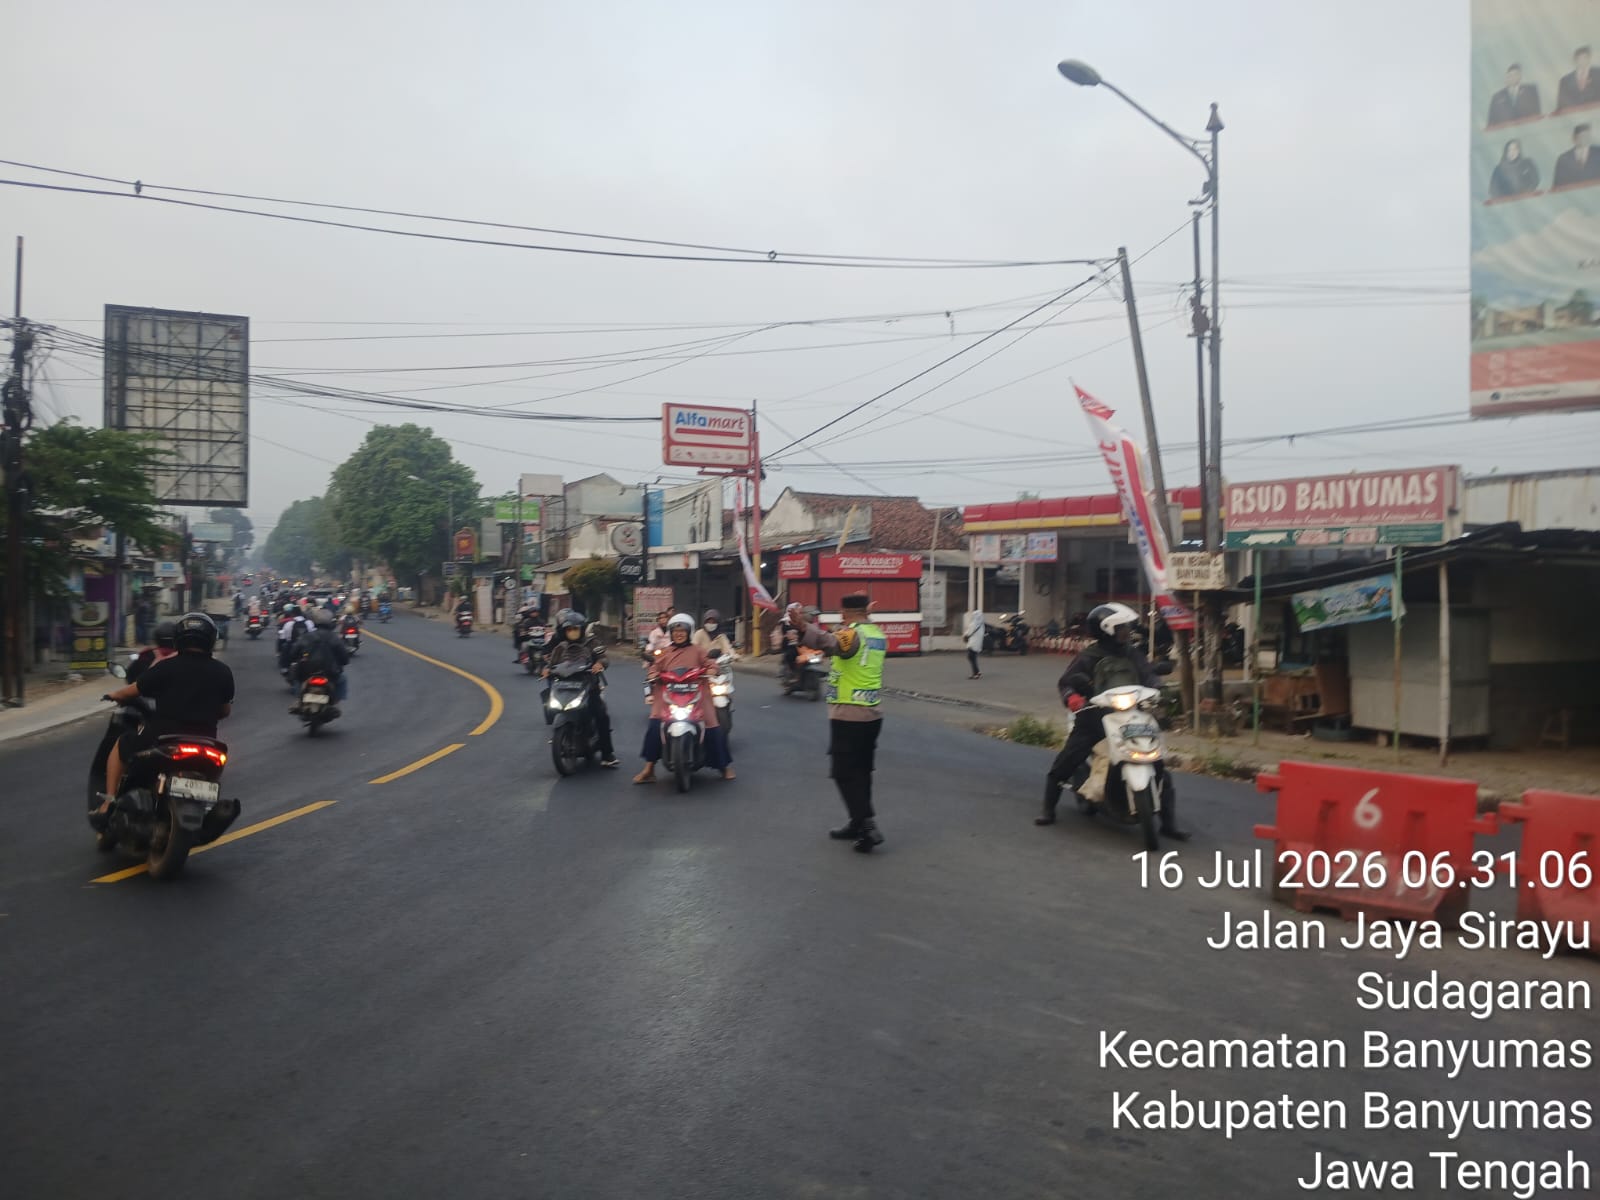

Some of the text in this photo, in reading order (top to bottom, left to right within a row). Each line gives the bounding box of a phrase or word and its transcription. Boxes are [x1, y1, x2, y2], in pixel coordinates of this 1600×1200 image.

[675, 411, 745, 430] Alfamart
[1230, 472, 1438, 515] RSUD BANYUMAS
[1353, 787, 1382, 828] 6
